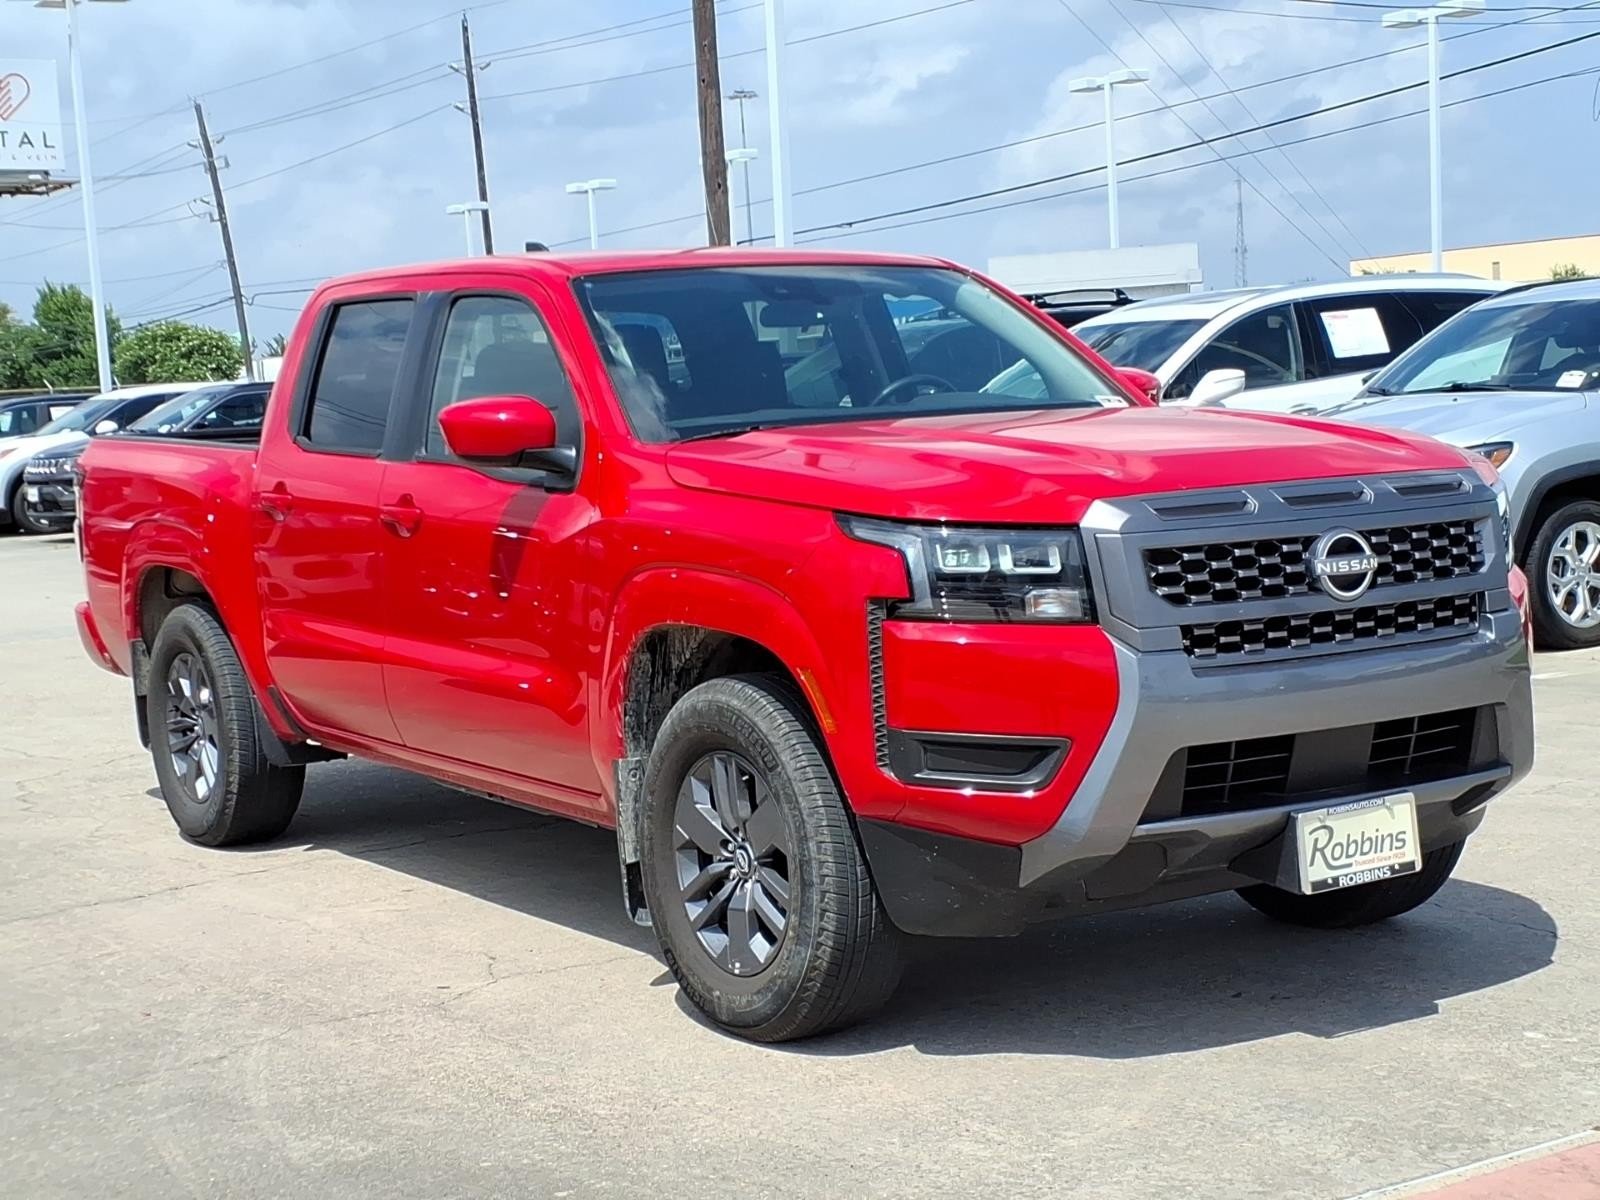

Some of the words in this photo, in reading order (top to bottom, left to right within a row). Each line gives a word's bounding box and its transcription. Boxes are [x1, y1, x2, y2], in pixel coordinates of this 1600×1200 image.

[1317, 558, 1378, 573] NISSAN
[1308, 824, 1407, 871] Robbins
[1338, 866, 1392, 887] ROBBINS
